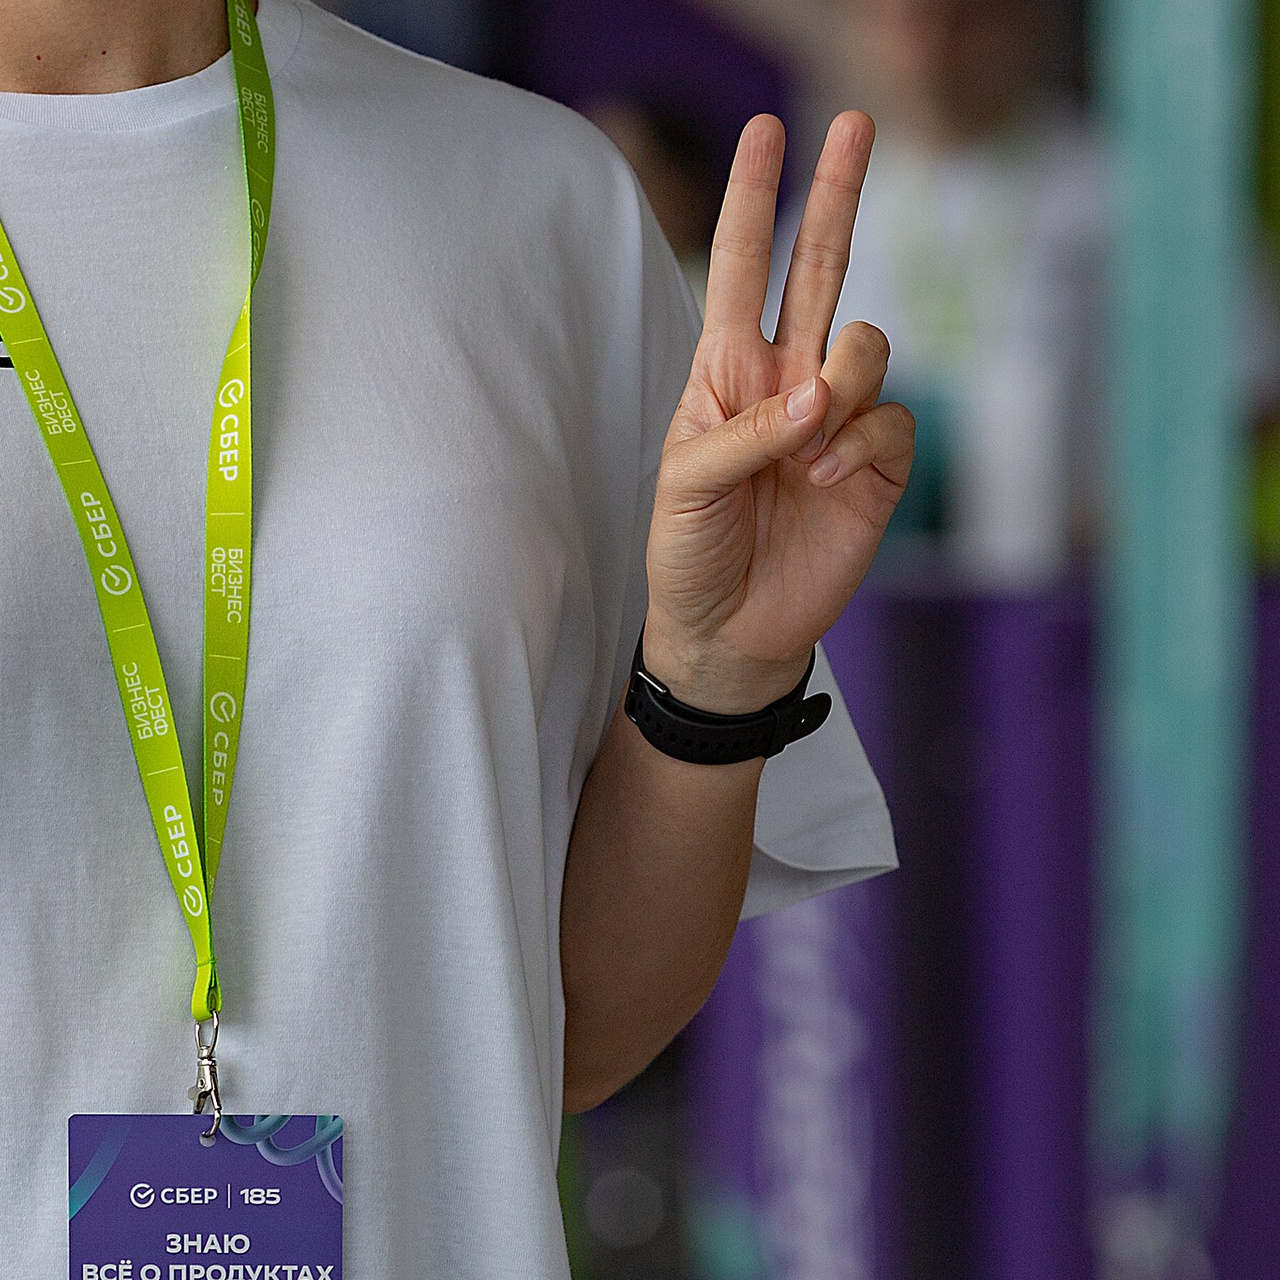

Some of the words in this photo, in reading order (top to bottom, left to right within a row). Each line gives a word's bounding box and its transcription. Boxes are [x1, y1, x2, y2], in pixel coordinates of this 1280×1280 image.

[241, 86, 255, 127] ФЕСТ
[253, 92, 269, 154] БИЗНЕС
[25, 369, 63, 435] БИЗНЕС
[49, 390, 76, 433] ФЕСТ
[218, 414, 239, 481] СБЕР
[80, 491, 117, 557] СБЕР
[211, 547, 226, 597] ФЕСТ
[227, 548, 243, 624] БИЗНЕС
[122, 662, 153, 740] БИЗНЕС
[145, 686, 169, 736] ФЕСТ
[212, 731, 229, 806] СБЕР
[164, 805, 193, 878] СБЕР
[160, 1187, 218, 1205] СБЕР
[239, 1188, 281, 1205] 185
[165, 1233, 250, 1254] ЗНАЮ
